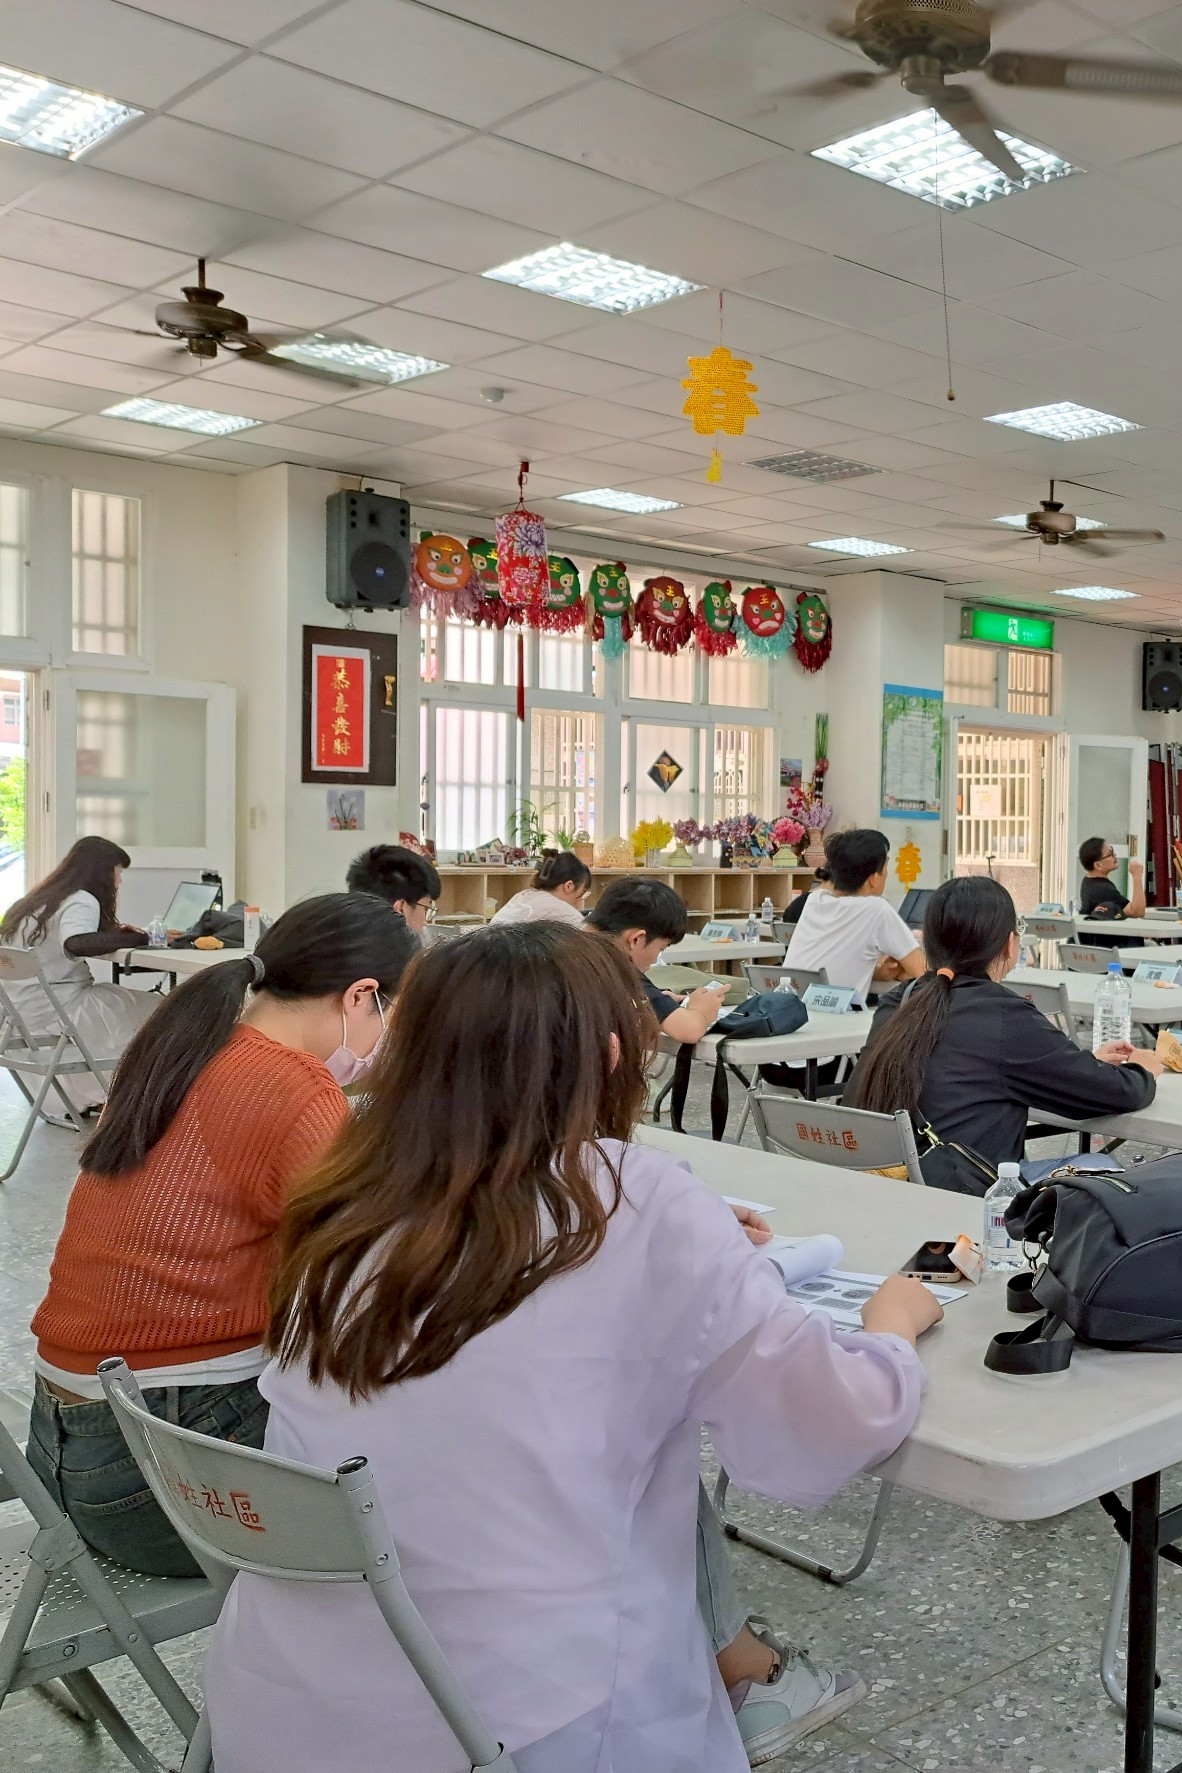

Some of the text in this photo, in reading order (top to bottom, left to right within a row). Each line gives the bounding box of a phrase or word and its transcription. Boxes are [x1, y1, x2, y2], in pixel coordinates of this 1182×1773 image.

[666, 585, 675, 597] 王
[760, 593, 769, 605] 王
[331, 668, 351, 757] 恭喜發財
[796, 1123, 858, 1150] 國姓社區
